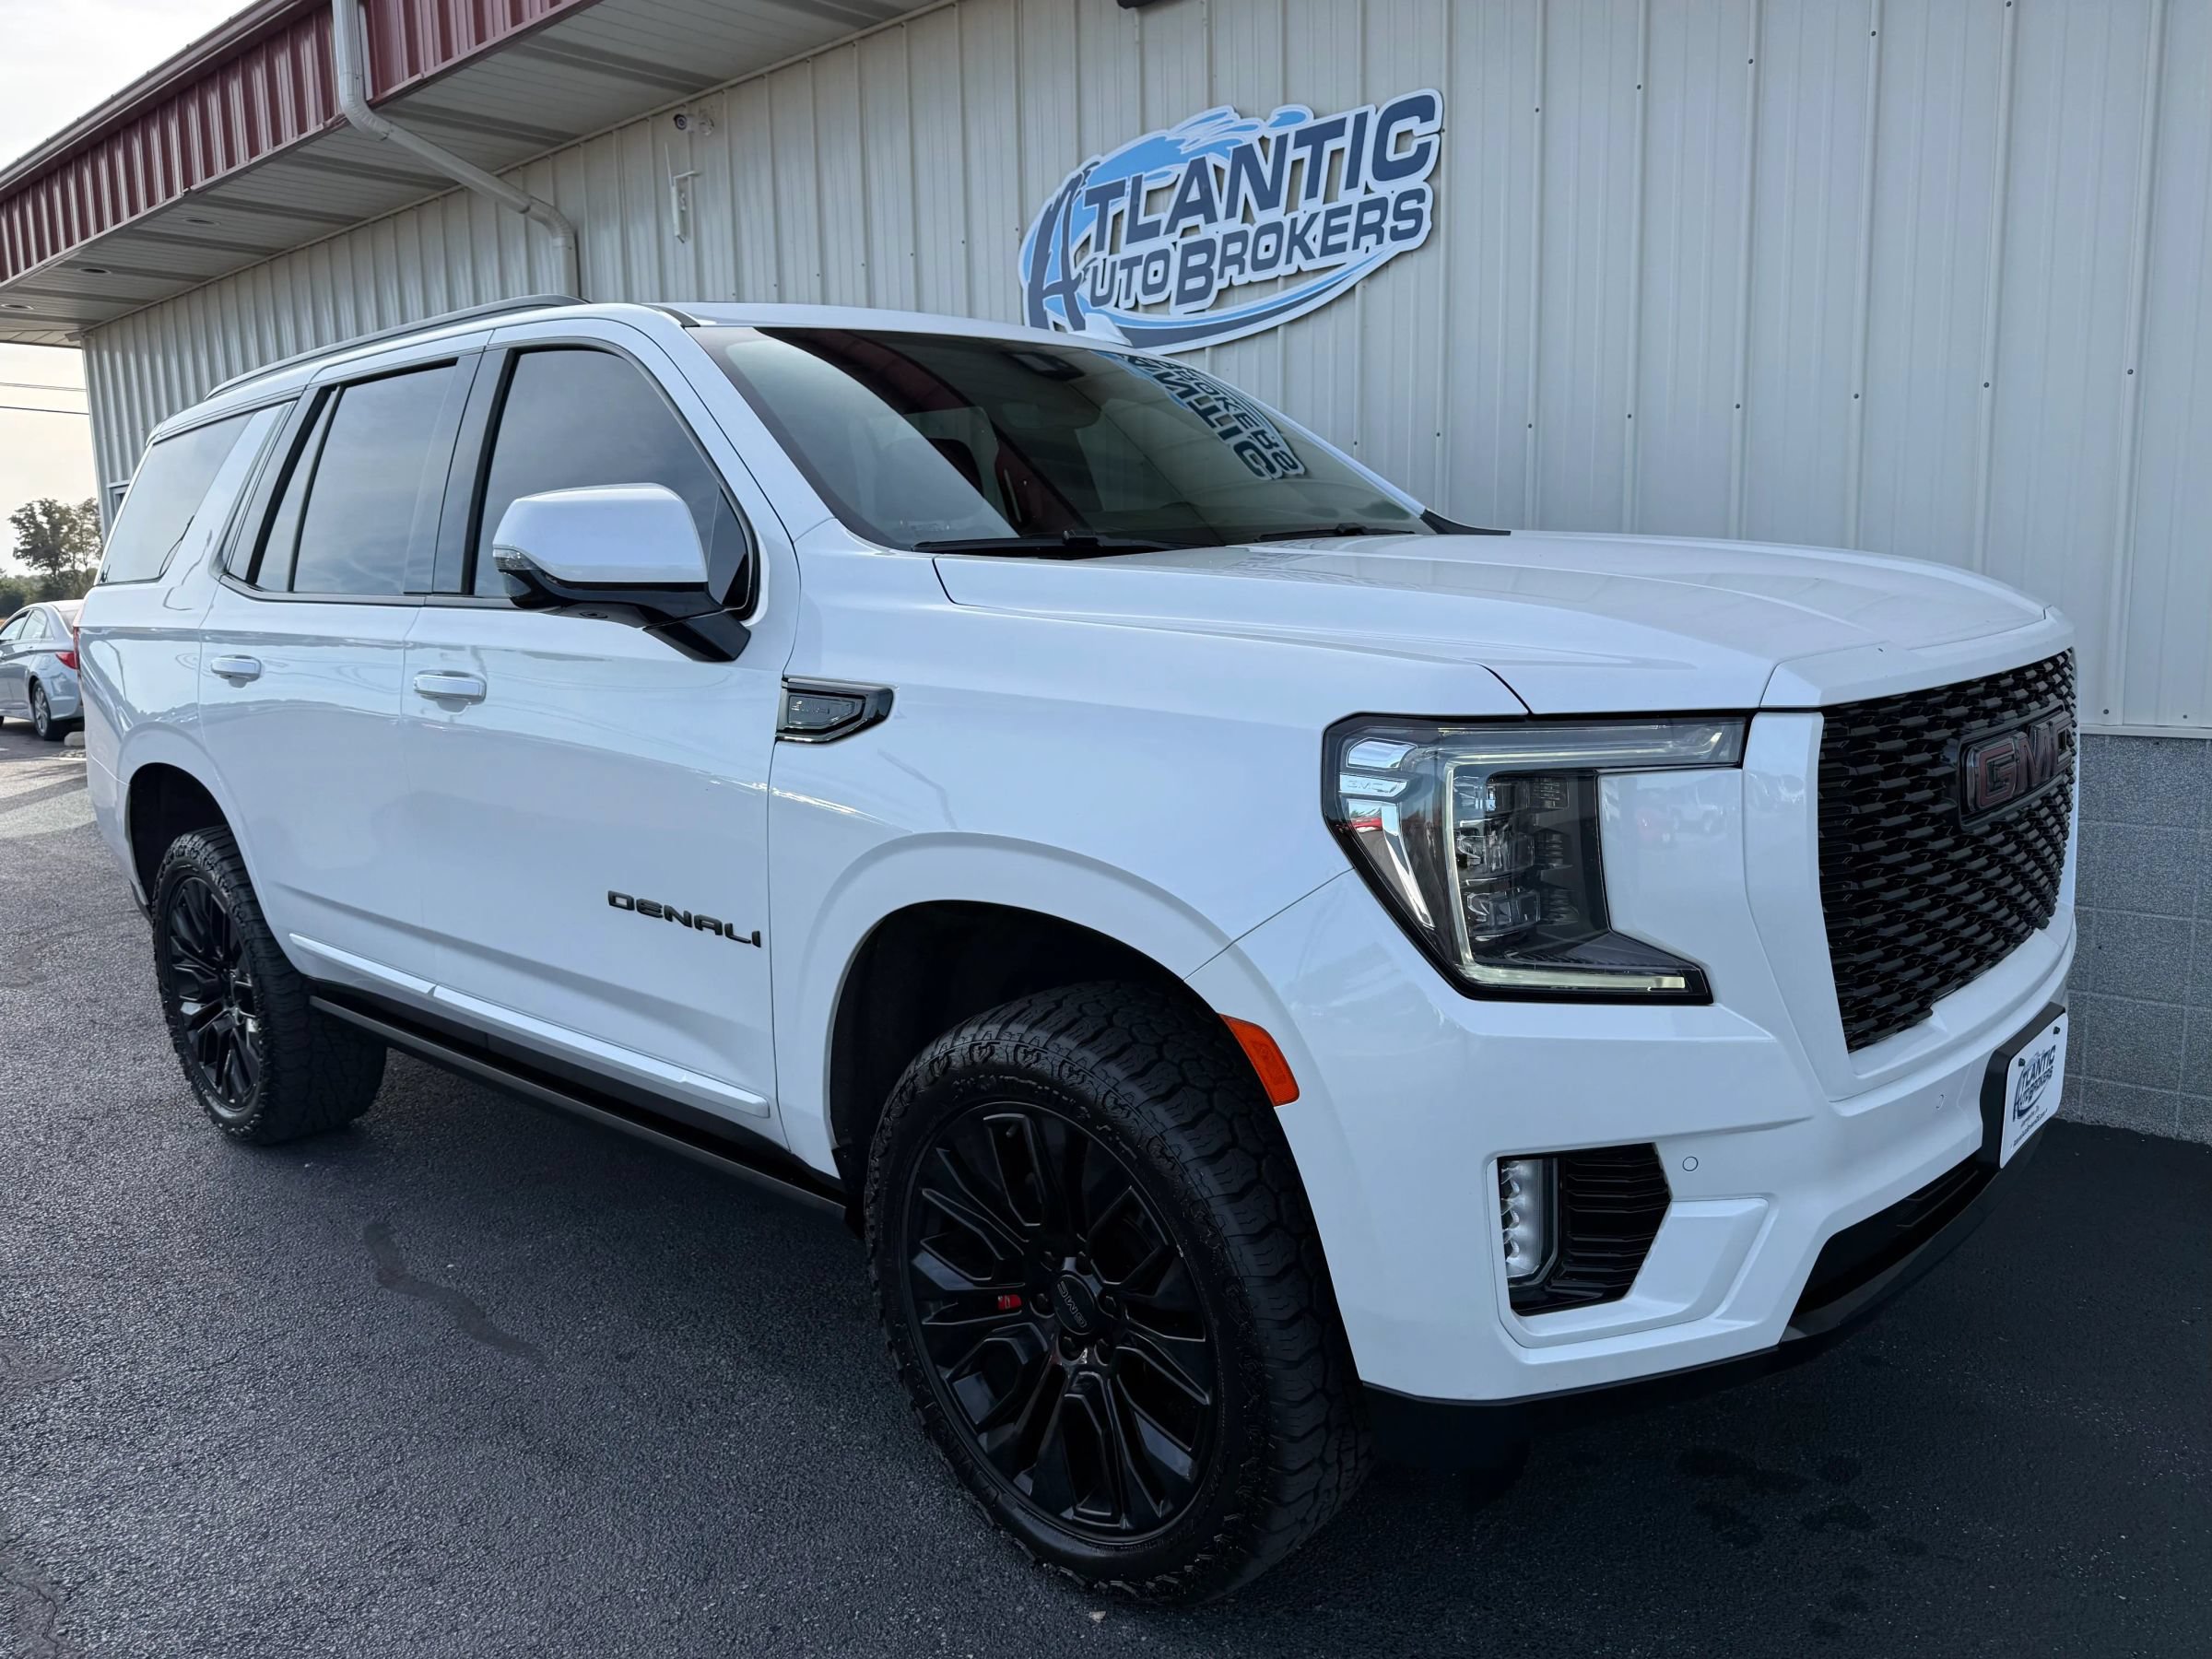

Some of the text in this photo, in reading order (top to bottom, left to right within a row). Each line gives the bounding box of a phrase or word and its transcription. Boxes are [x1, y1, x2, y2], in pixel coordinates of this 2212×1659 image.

[1026, 94, 1436, 330] ATLANTIC
[1967, 711, 2073, 812] GMC
[607, 889, 762, 948] DENALI
[1057, 1280, 1088, 1328] GMC
